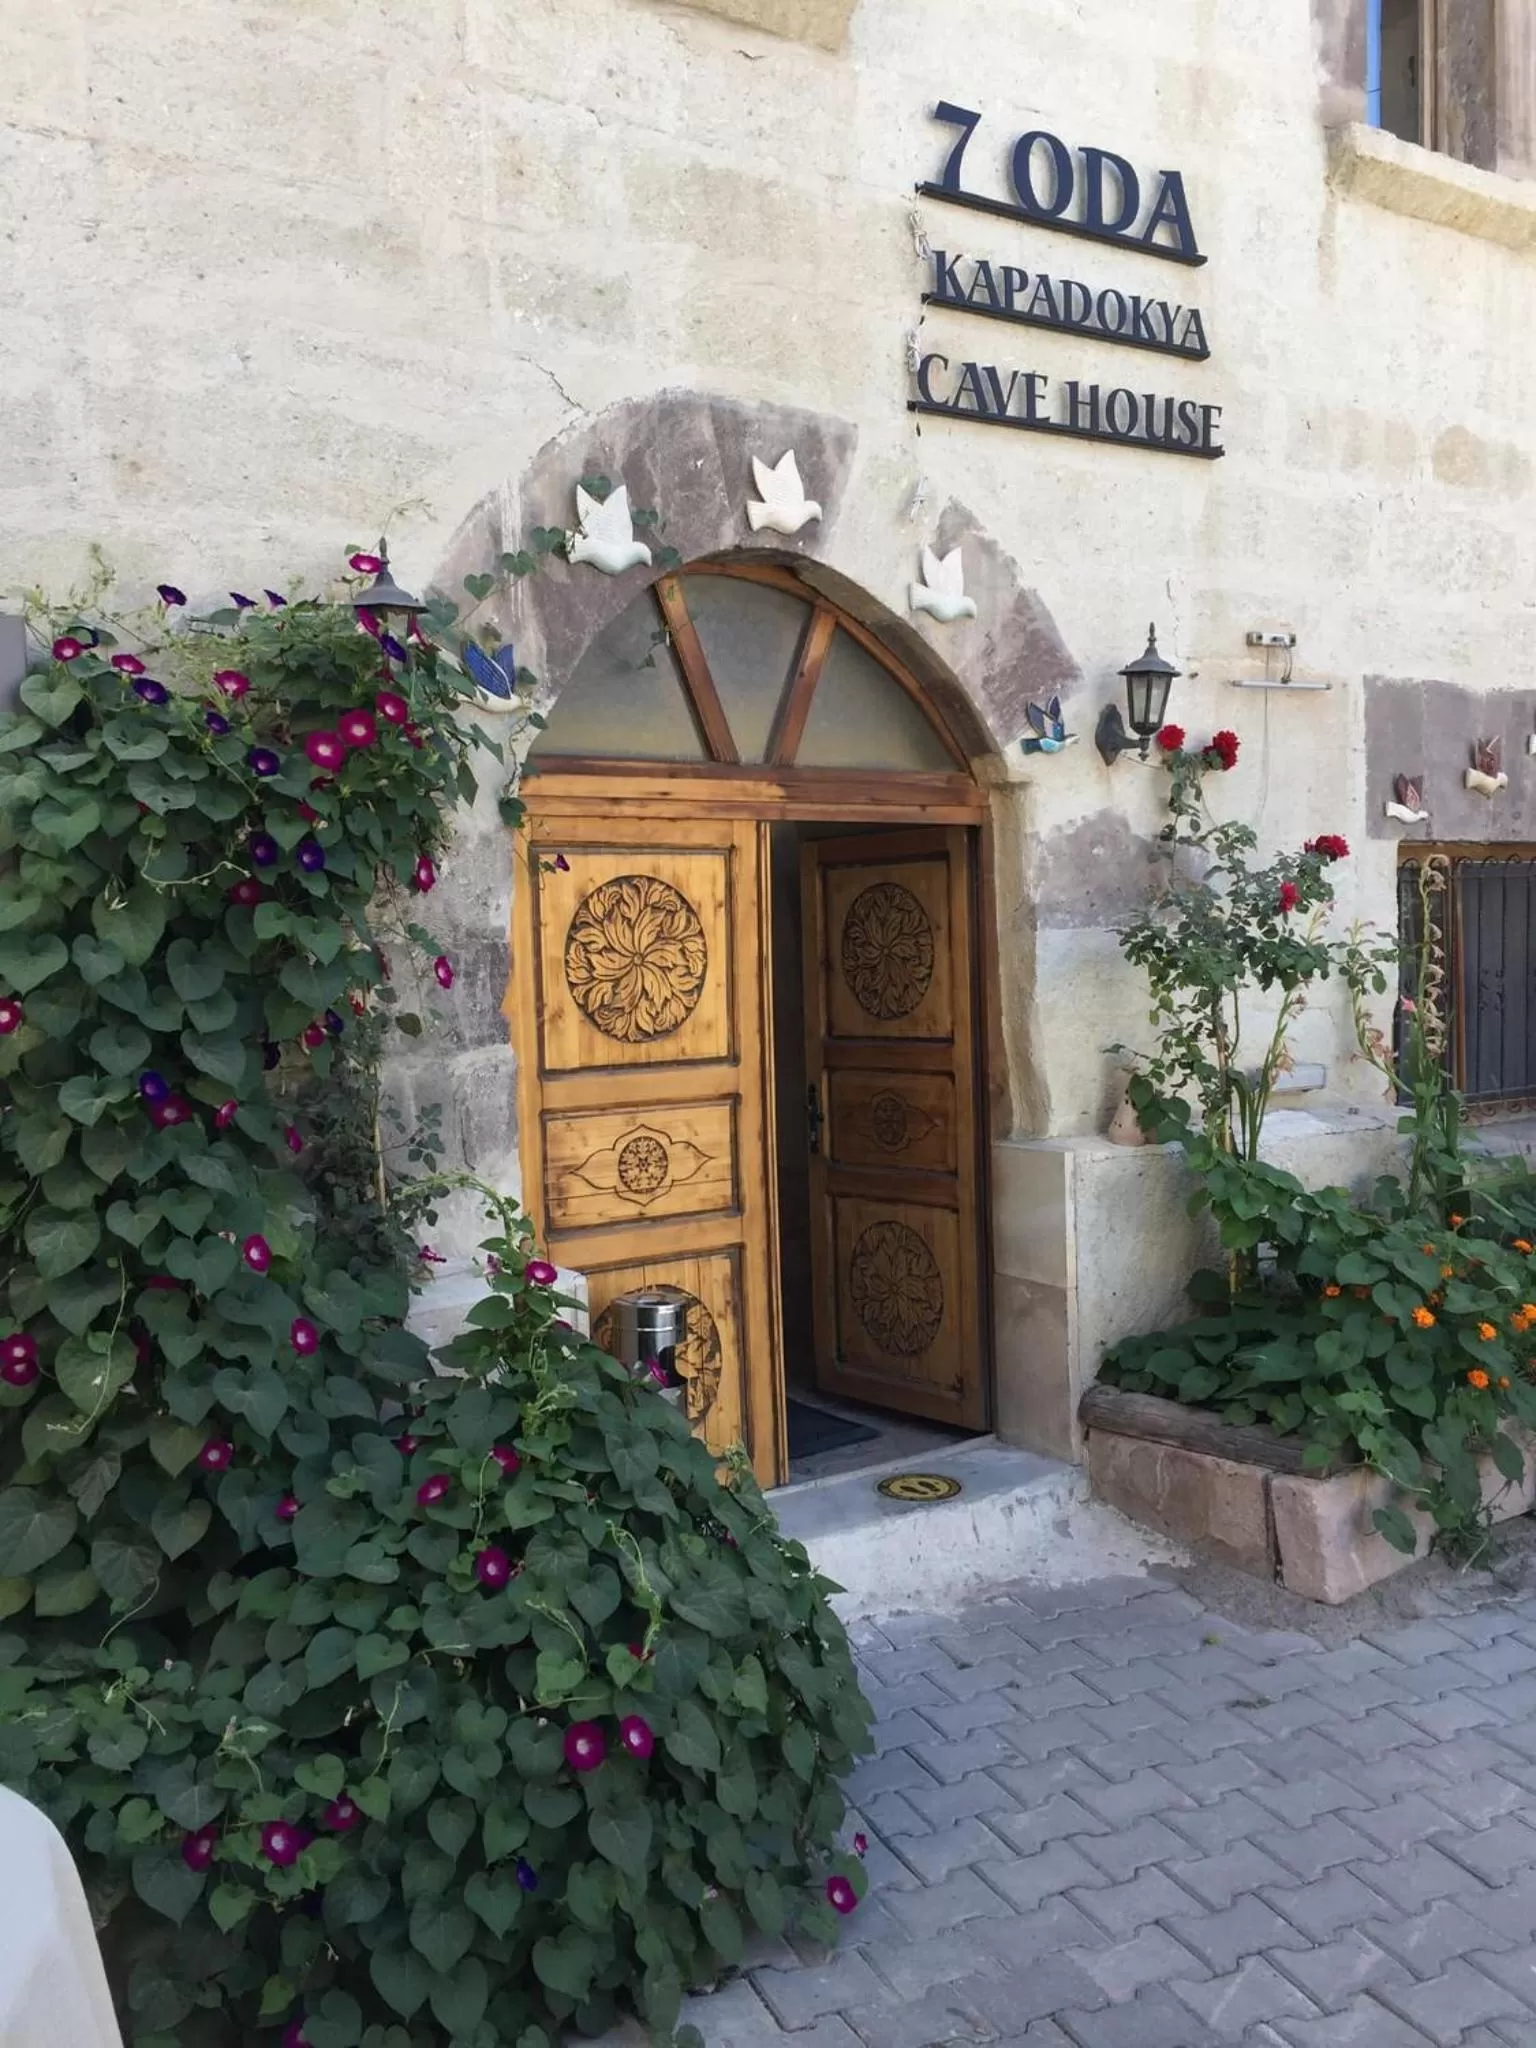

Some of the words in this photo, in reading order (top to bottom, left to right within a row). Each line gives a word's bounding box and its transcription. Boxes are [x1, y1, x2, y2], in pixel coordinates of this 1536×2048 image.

[933, 100, 982, 192] 7
[1012, 130, 1200, 254] ODA
[931, 250, 1210, 352] KAPADOKYA
[917, 353, 1051, 424] CAVE
[1064, 380, 1224, 450] HOUSE
